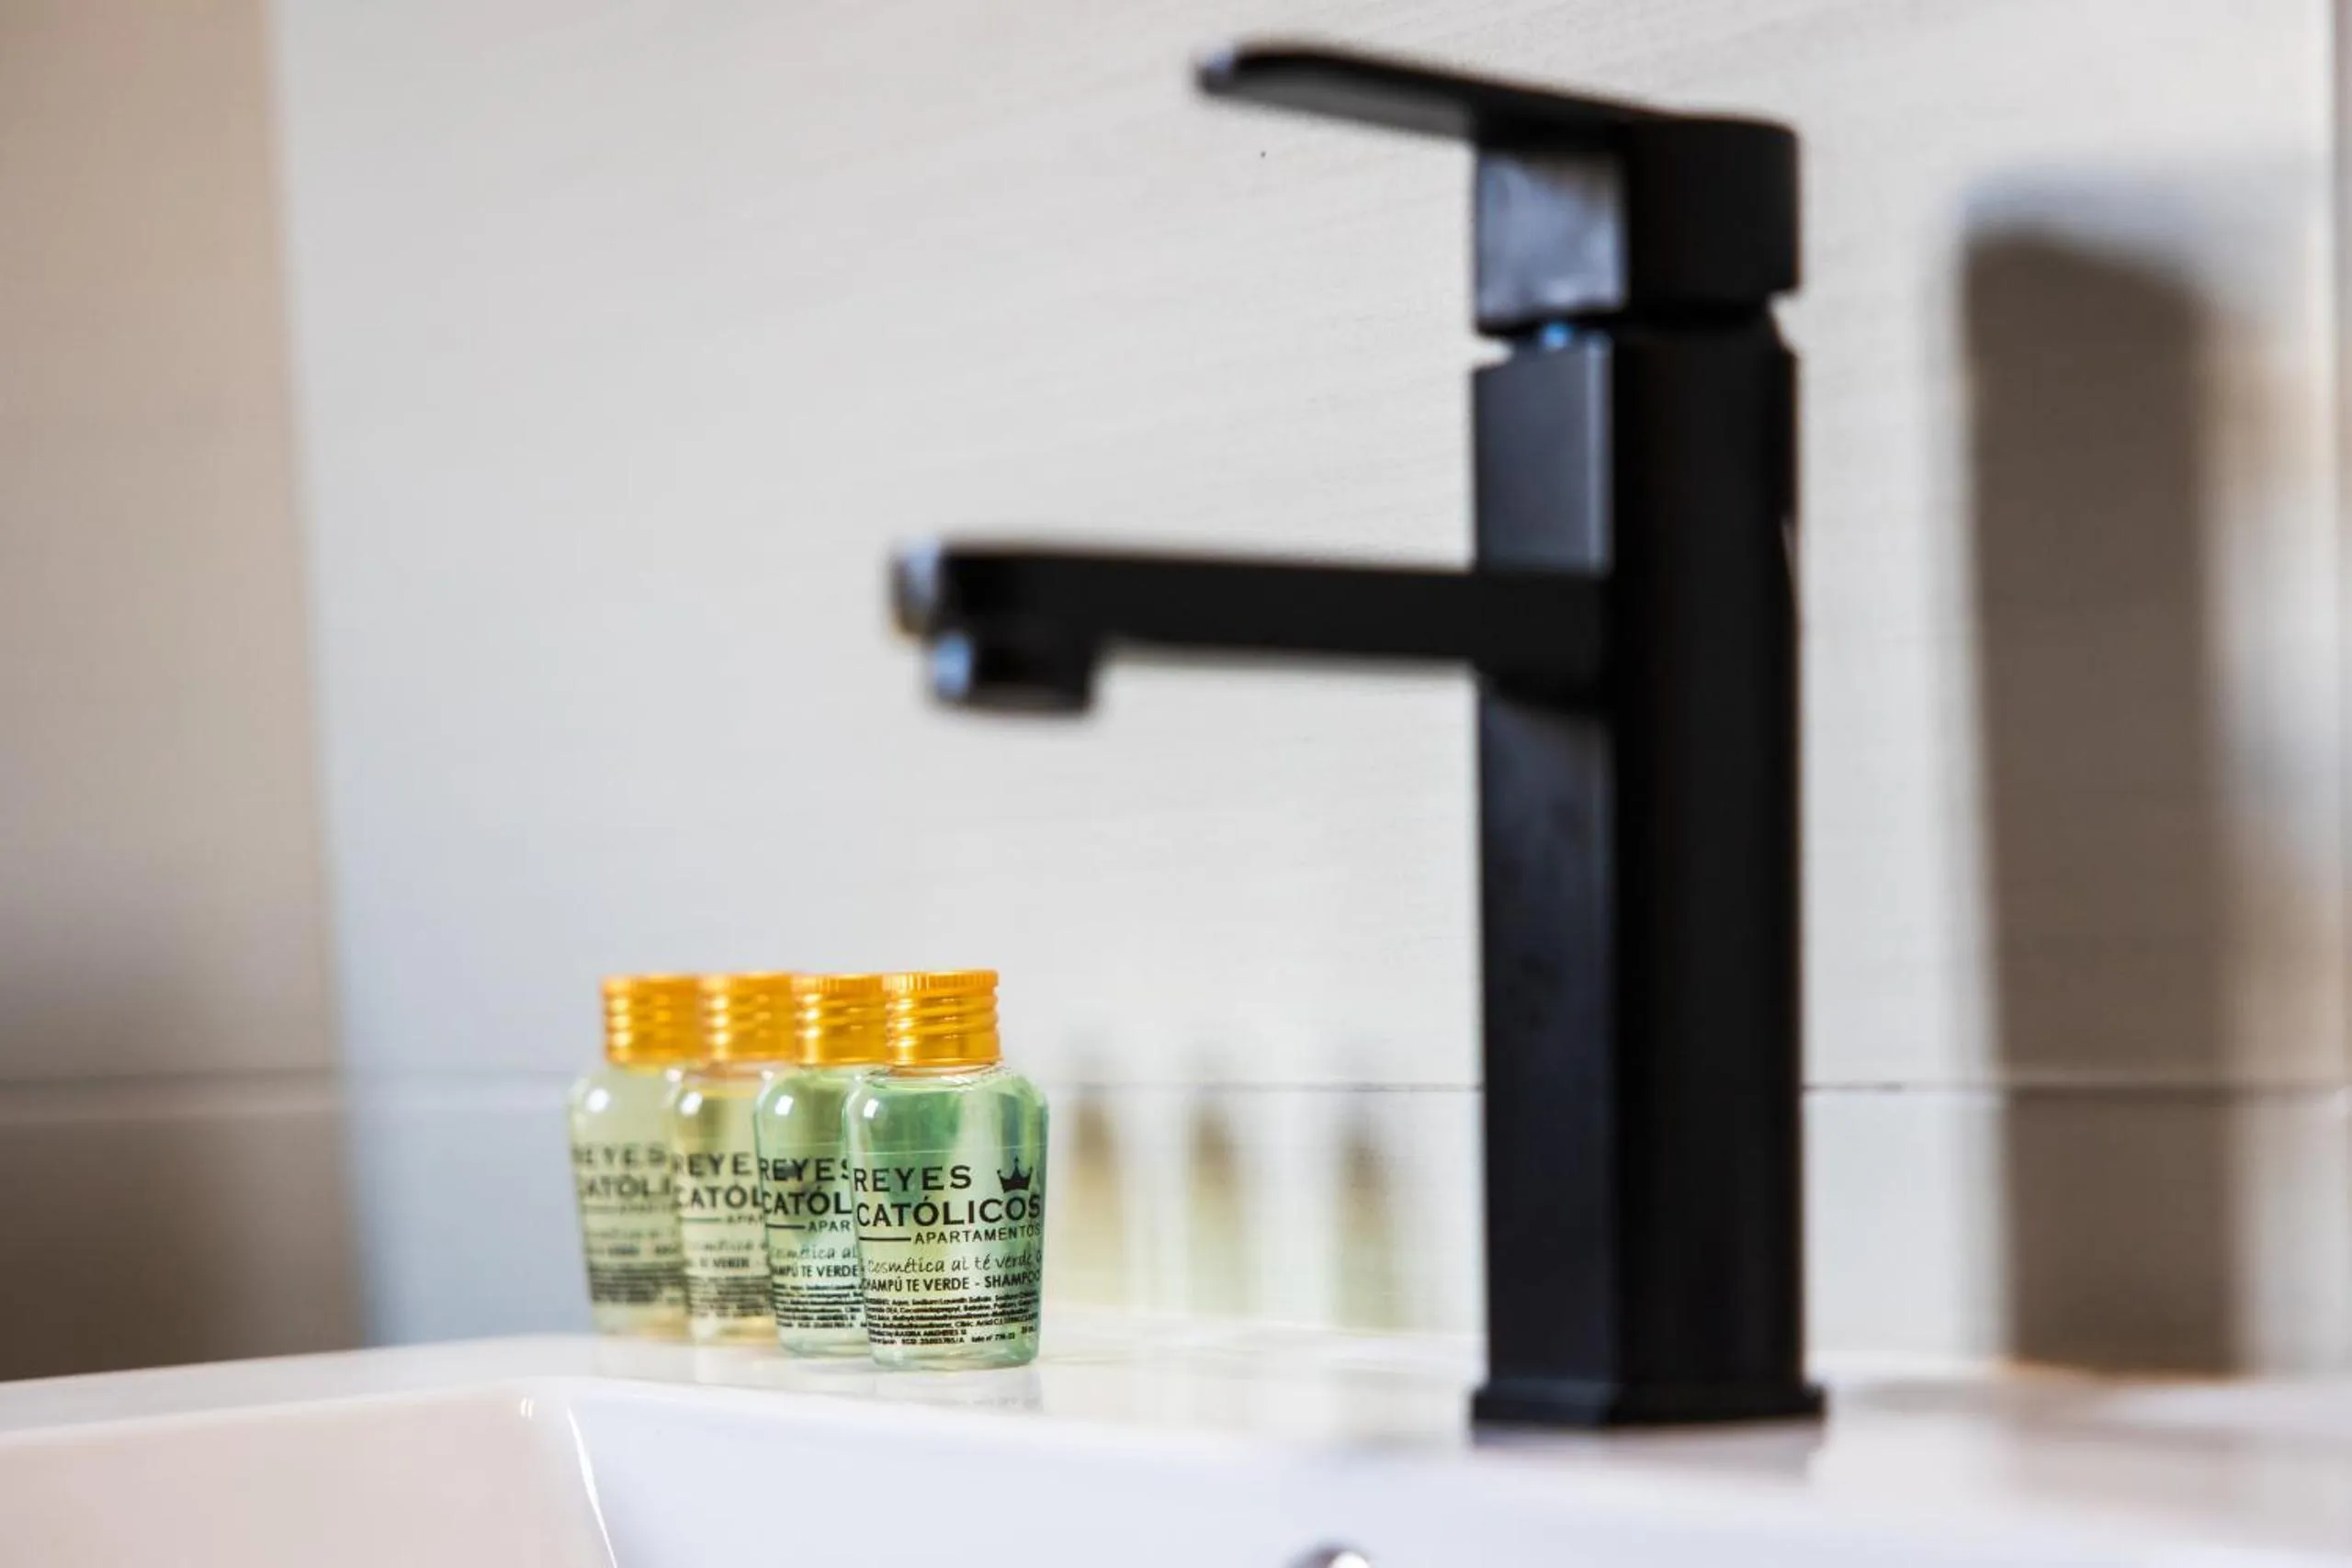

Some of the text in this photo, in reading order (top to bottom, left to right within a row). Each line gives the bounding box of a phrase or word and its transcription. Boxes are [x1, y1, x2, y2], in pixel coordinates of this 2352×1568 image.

[853, 1165, 972, 1192] REYES
[856, 1193, 1041, 1227] CATÓLICOS
[914, 1224, 1041, 1246] APARTAMENTOS
[974, 1252, 991, 1271] té
[995, 1248, 1032, 1269] verde
[817, 1264, 858, 1278] VERDE
[906, 1279, 920, 1292] TE
[922, 1278, 970, 1292] VERDE
